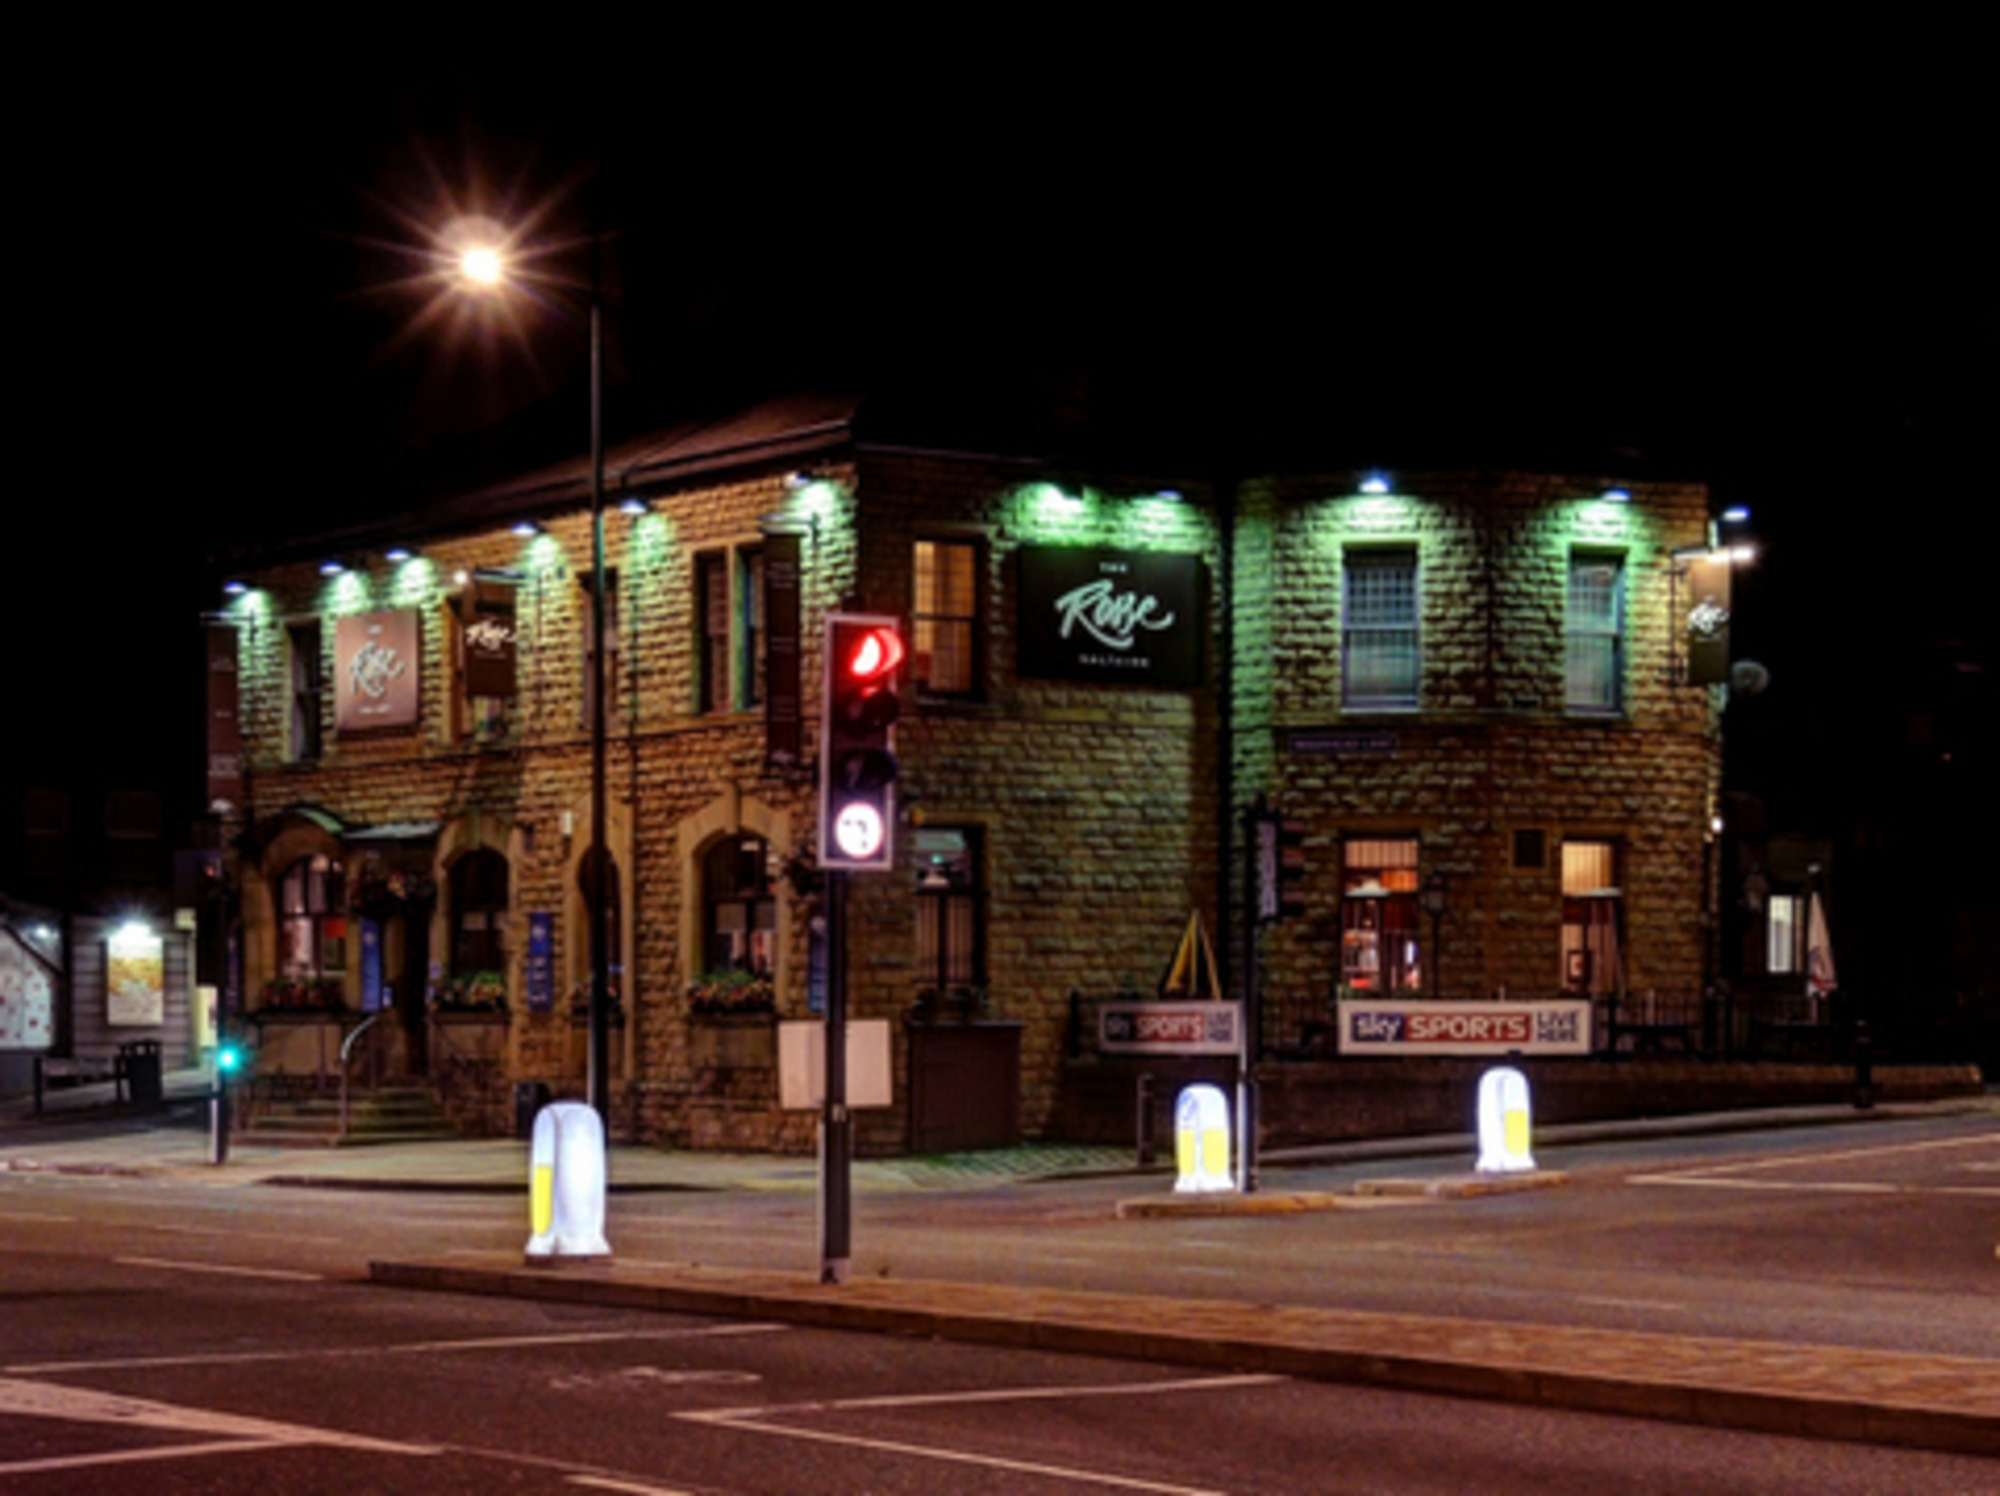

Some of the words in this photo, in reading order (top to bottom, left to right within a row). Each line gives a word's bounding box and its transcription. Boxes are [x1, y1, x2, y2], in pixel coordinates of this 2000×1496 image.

[1054, 578, 1176, 649] Rose
[1135, 1015, 1203, 1040] SPORTS
[1357, 1011, 1400, 1044] sky
[1409, 1015, 1526, 1039] SPORTS
